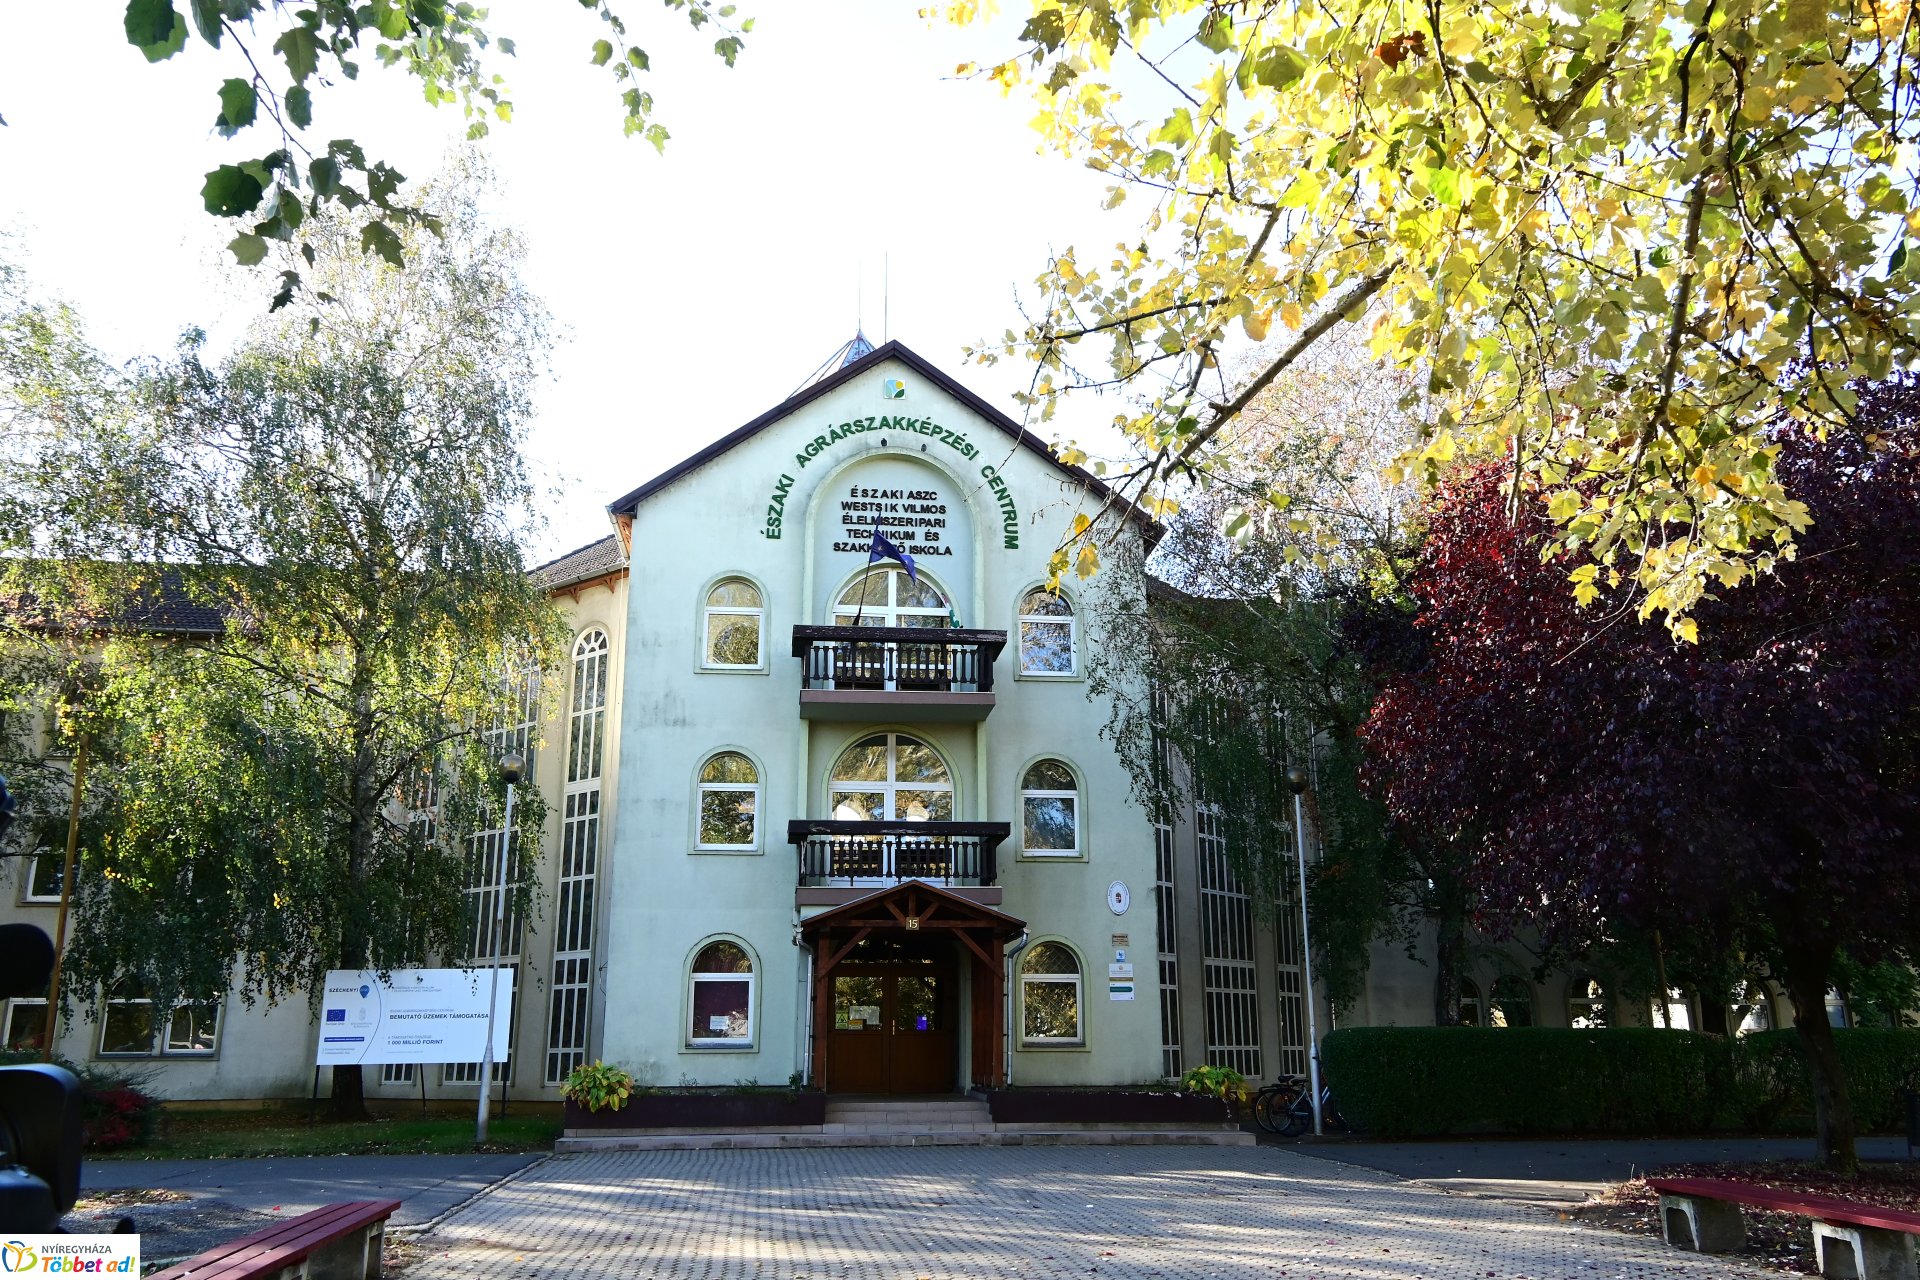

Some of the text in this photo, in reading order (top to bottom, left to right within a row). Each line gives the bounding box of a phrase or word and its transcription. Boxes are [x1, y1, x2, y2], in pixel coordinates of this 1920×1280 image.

[760, 416, 1019, 550] ÉSZAKI AGRÁRSZAKKÉPZÉSI CENTRUM
[850, 485, 937, 500] ÉSZAKI ASZC
[841, 501, 946, 514] WESTSIK VILMOS
[924, 529, 940, 541] ÉS
[909, 545, 952, 556] ISKOLA
[908, 919, 918, 928] 15
